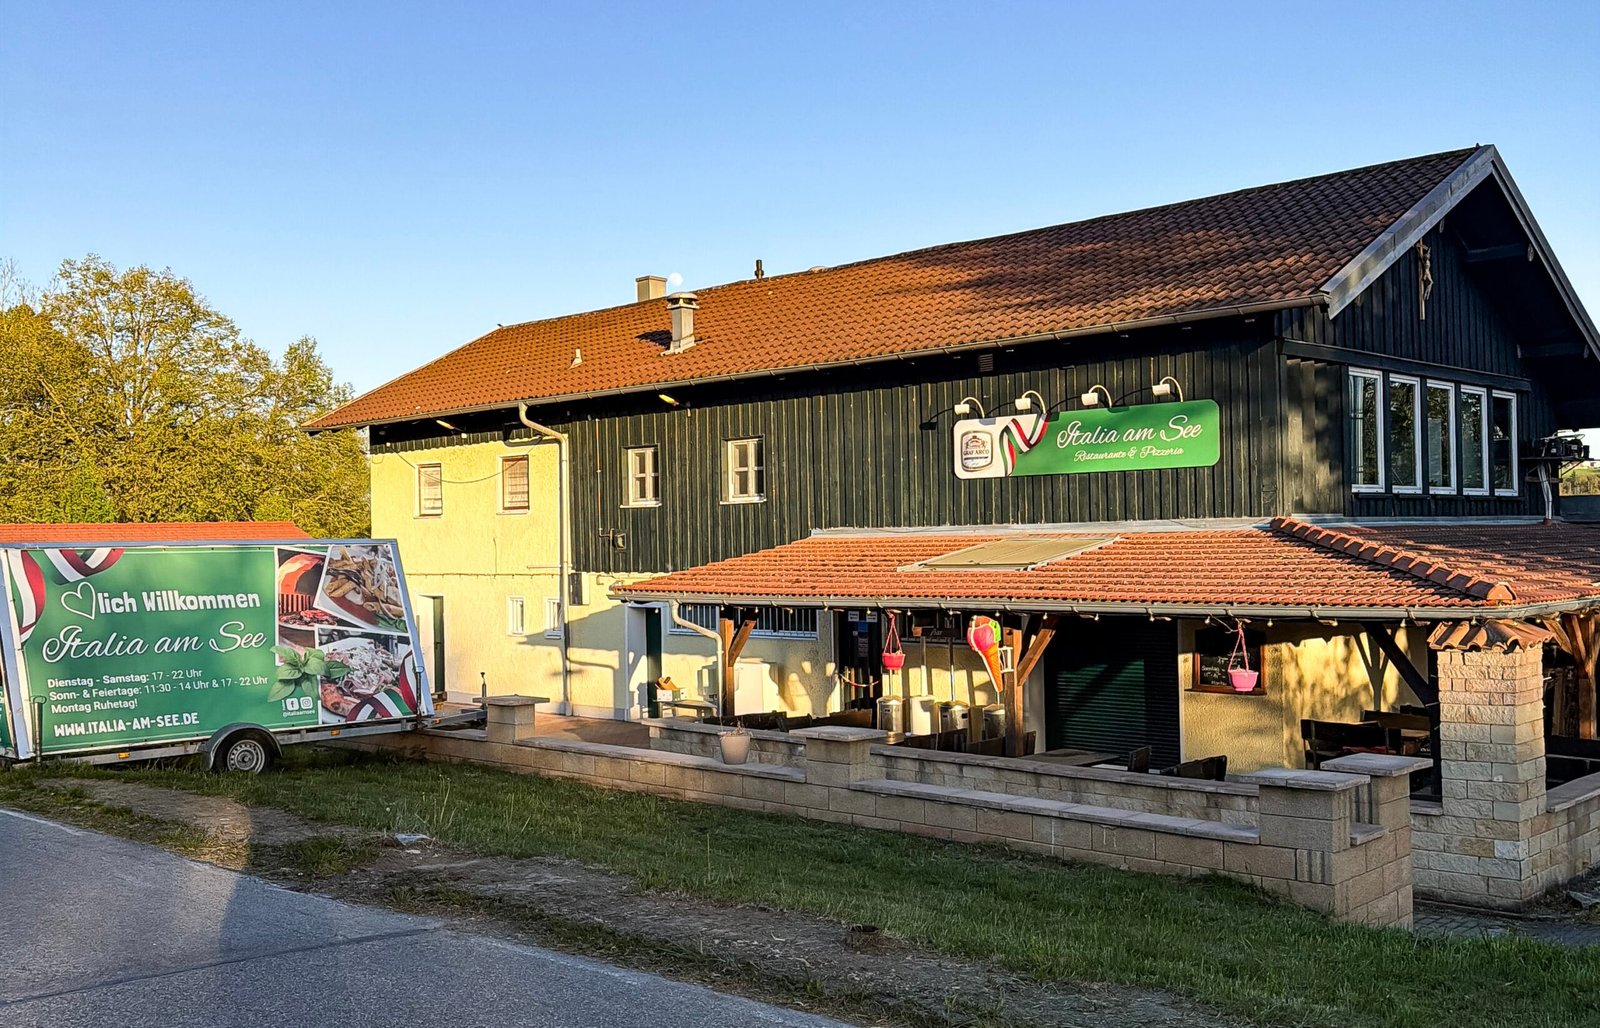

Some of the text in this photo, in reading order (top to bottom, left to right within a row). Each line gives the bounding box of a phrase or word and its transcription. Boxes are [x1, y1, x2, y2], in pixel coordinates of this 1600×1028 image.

[1056, 414, 1203, 449] Italia am See
[1127, 446, 1138, 460] &
[1139, 445, 1185, 458] Pizzeria
[97, 589, 261, 615] lich Willkommen
[42, 621, 267, 663] Italia am See
[47, 677, 94, 688] Dienstag
[102, 673, 150, 684] Samstag:
[151, 671, 164, 681] 17
[171, 670, 184, 680] 22
[185, 668, 203, 678] Uhr
[49, 691, 80, 701] Sonn-
[82, 689, 91, 699] &
[92, 686, 143, 698] Feiertage:
[144, 683, 171, 694] 11:30
[179, 682, 191, 691] 14
[192, 680, 210, 690] Uhr
[211, 679, 220, 688] &
[220, 678, 232, 688] 17
[239, 677, 252, 686] 22
[252, 676, 269, 685] Uhr
[50, 698, 138, 714] Montag Ruhetag!
[53, 712, 200, 737] WWW.ITALIA-AM-SEE.DE
